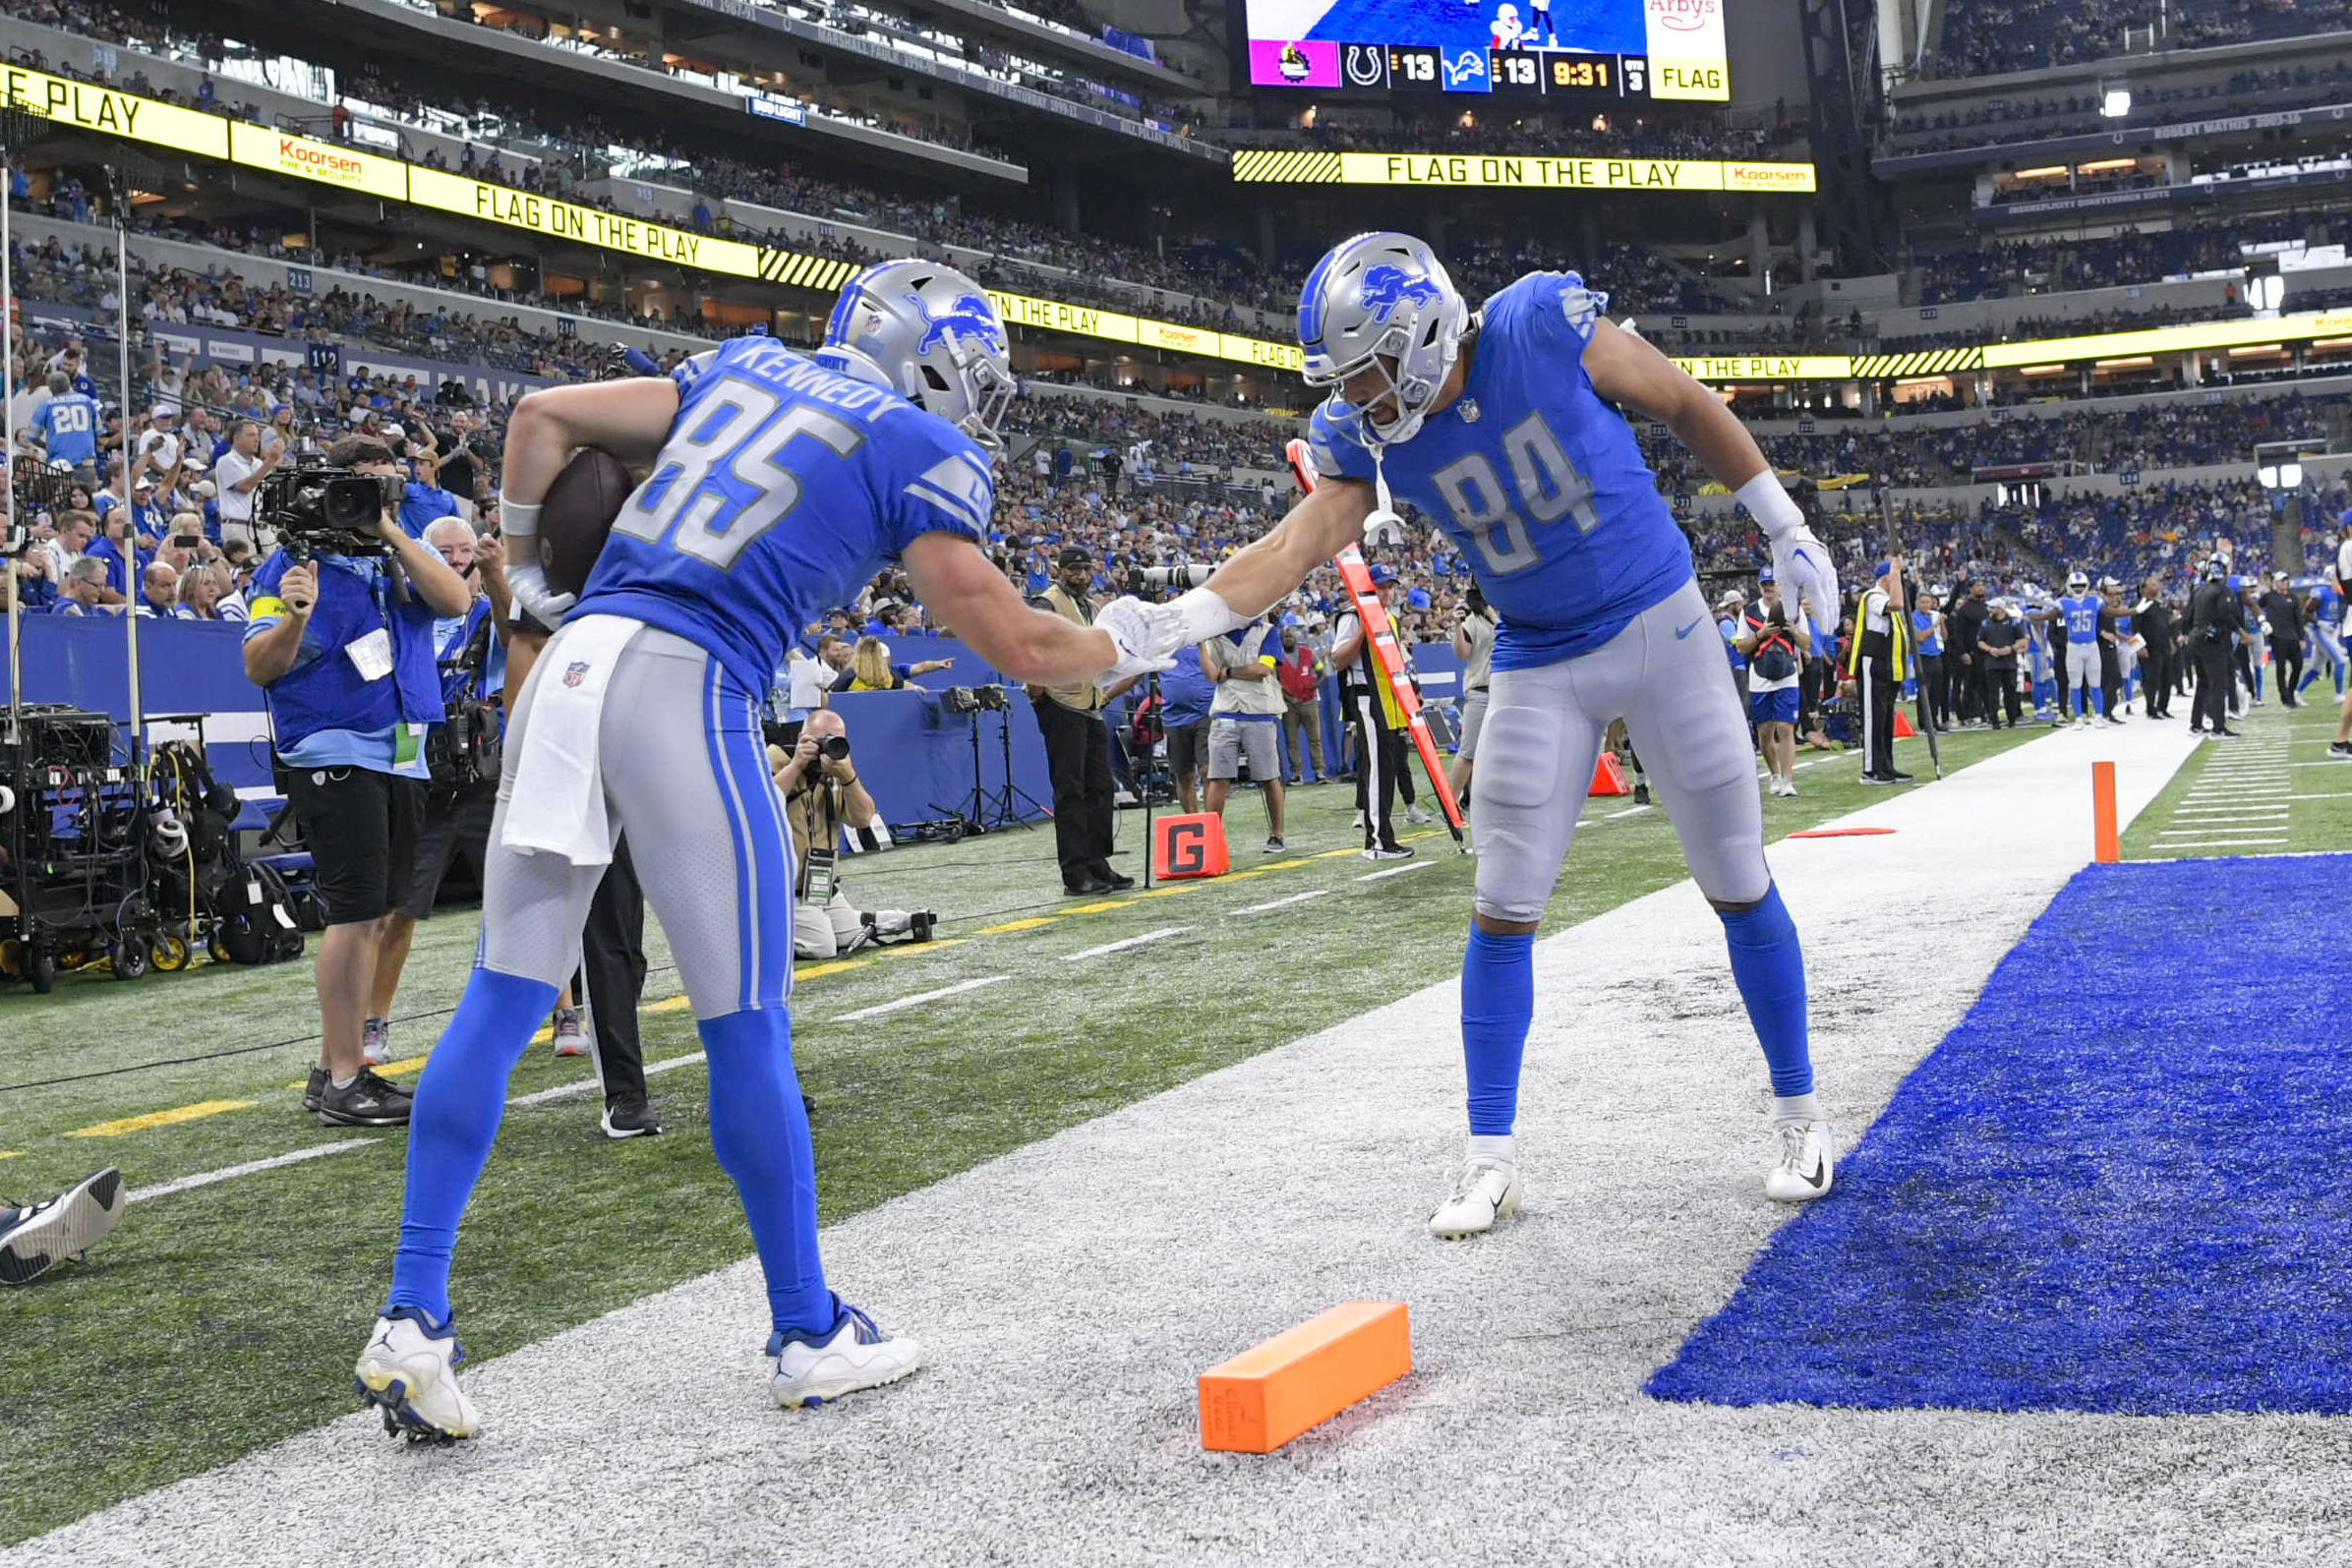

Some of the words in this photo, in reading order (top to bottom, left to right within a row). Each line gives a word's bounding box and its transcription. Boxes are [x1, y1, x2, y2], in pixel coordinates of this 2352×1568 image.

[1402, 54, 1435, 81] 13
[1504, 58, 1536, 85] 13
[1553, 62, 1608, 87] 9:31
[1628, 72, 1643, 90] 3
[1663, 68, 1721, 89] FLAG
[47, 80, 140, 134] PLAY
[776, 102, 802, 121] LIGHT
[2154, 124, 2200, 140] ROBERT
[2205, 120, 2250, 135] MATHIS
[279, 139, 362, 174] Koorsen
[1387, 157, 1466, 182] FLAG
[1482, 159, 1522, 183] ON
[1537, 160, 1595, 185] THE
[1608, 162, 1679, 186] PLAY
[1735, 167, 1805, 182] Koorsen
[477, 185, 540, 227] FLAG
[552, 203, 584, 238] ON
[593, 214, 637, 250] THE
[647, 227, 698, 263] PLAY
[289, 272, 310, 289] 213
[1019, 299, 1052, 326] THE
[1059, 306, 1098, 334] PLAY
[1253, 342, 1285, 366] FLAG
[1702, 360, 1742, 376] THE
[1751, 360, 1800, 376] PLAY
[732, 344, 911, 423] KENNEDY
[52, 405, 88, 434] 20
[611, 377, 865, 574] 85
[1430, 409, 1601, 575] 84
[2071, 610, 2092, 632] 35
[1167, 822, 1205, 873] G
